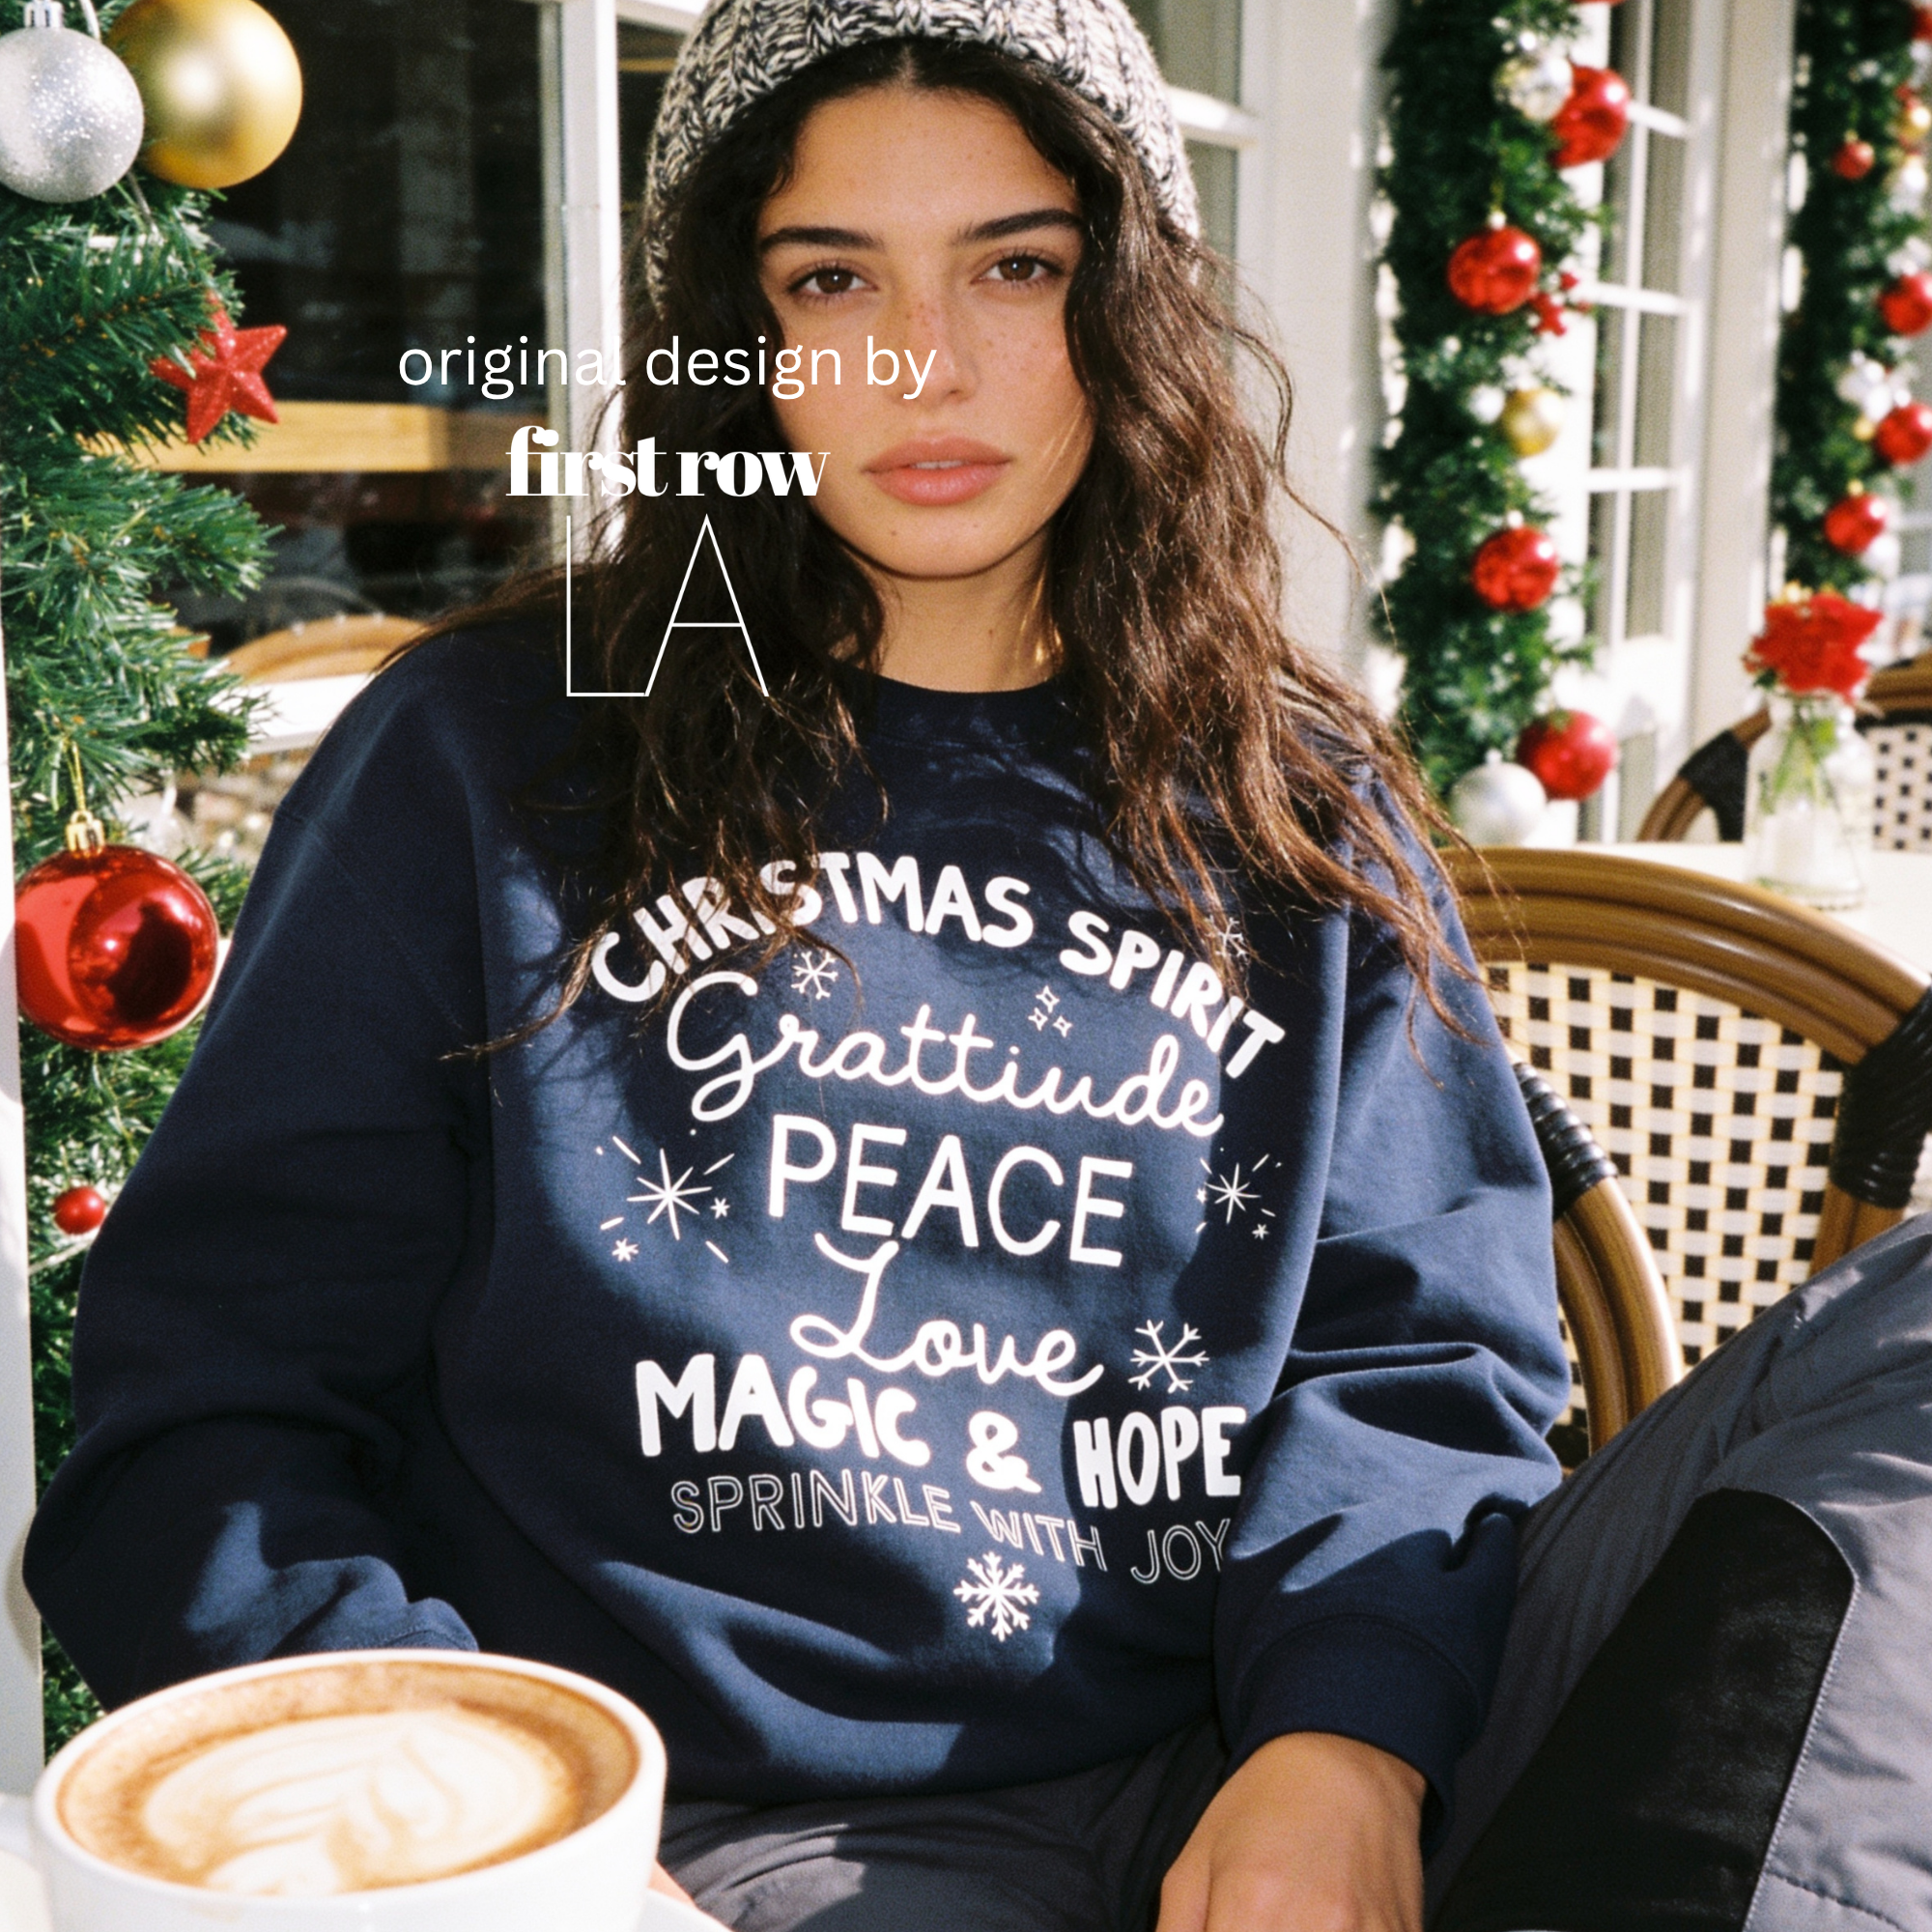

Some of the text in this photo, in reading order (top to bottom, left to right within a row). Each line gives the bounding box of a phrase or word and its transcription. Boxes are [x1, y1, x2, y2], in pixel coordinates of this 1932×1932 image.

[667, 971, 1224, 1137] Grattiude
[1061, 911, 1285, 1078] SPIRIT
[768, 1114, 1133, 1267] PEACE
[789, 1232, 1104, 1397] Love
[636, 1352, 1248, 1509] MAGIC & HOPE
[670, 1468, 1231, 1584] SPRINKLE WITH JOY
